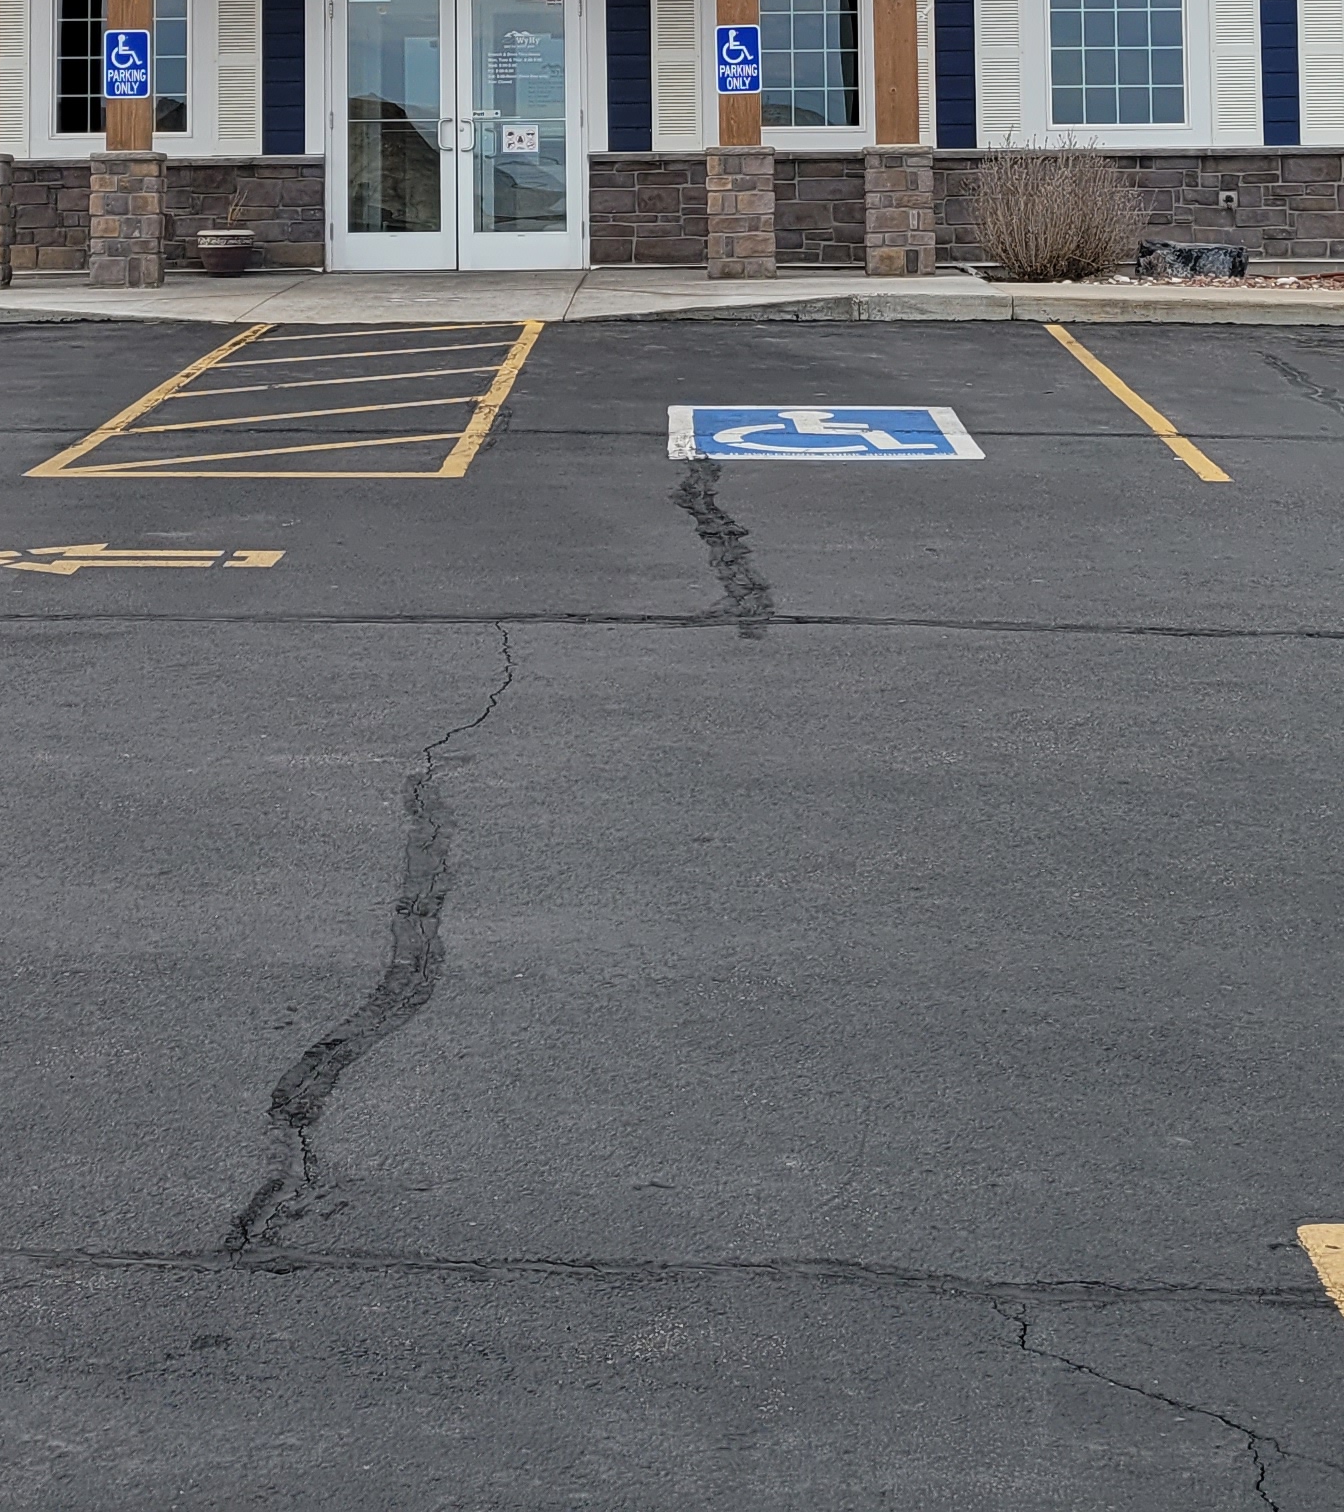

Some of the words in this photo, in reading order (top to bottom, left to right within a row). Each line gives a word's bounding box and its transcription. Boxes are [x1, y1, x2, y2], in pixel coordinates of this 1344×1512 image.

[107, 69, 146, 82] PARKING
[719, 64, 758, 78] PARKING
[114, 82, 139, 95] ONLY
[726, 77, 751, 90] ONLY
